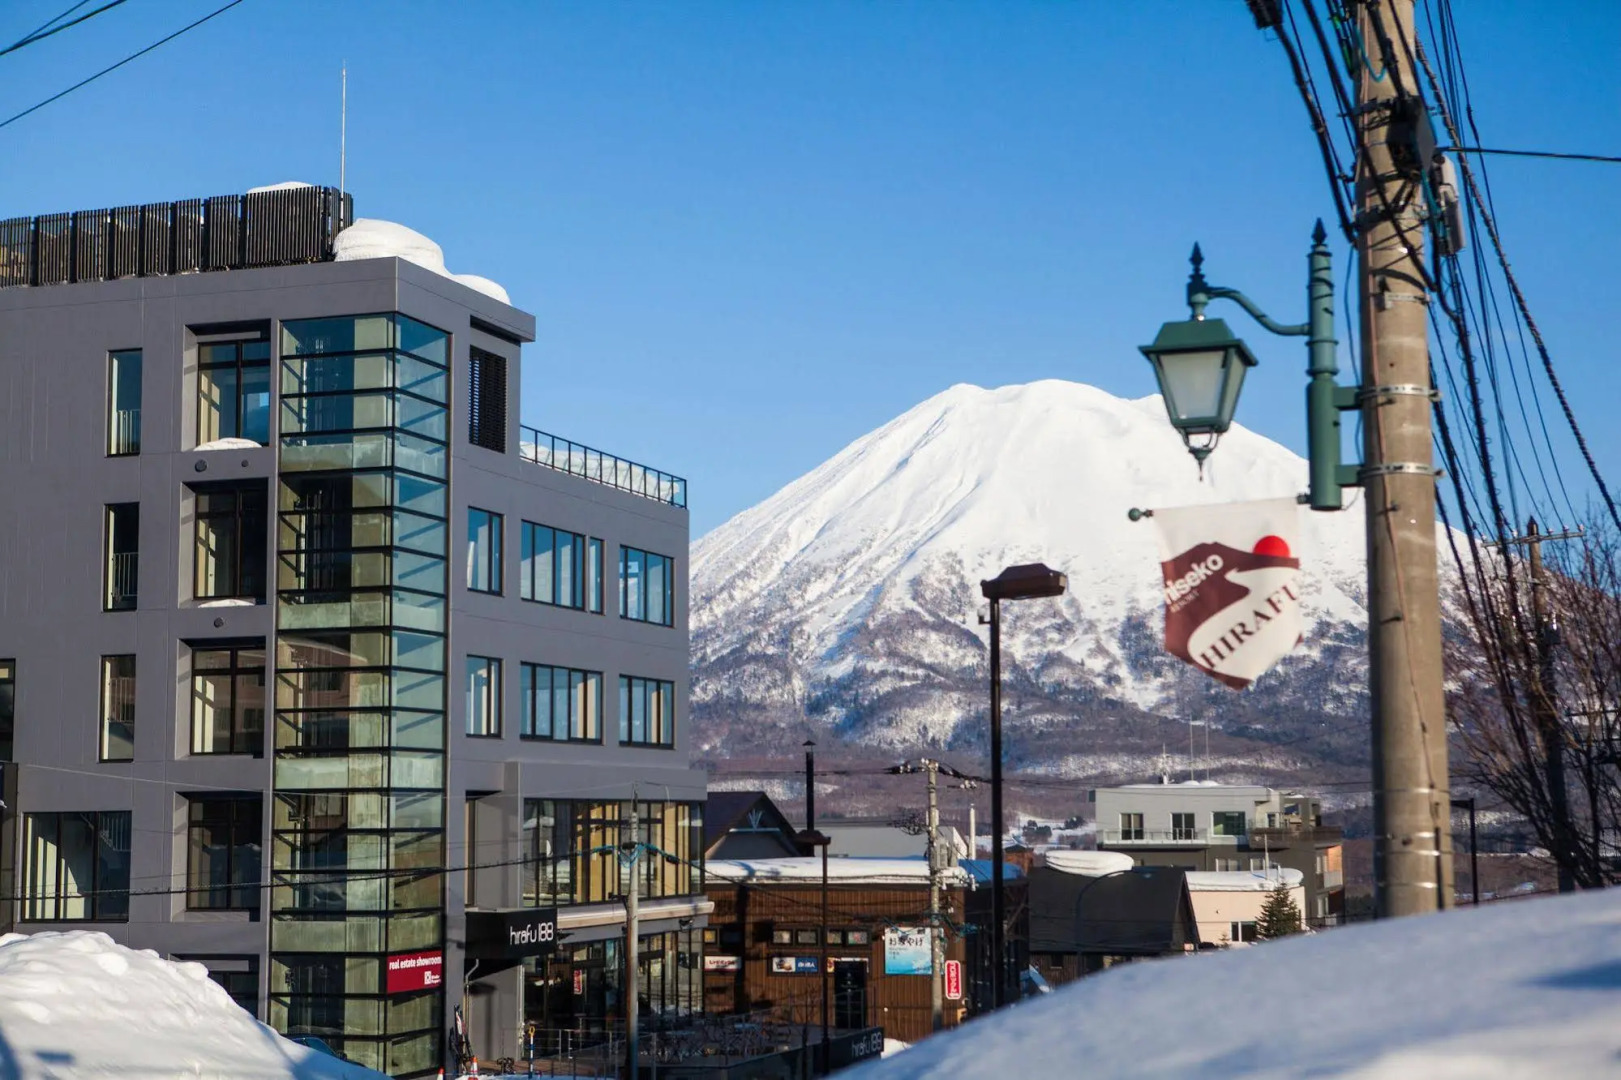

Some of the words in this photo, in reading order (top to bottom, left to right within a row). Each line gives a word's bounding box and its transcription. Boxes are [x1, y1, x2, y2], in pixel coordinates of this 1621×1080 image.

[510, 925, 537, 945] hirafu
[538, 922, 554, 941] 188
[389, 958, 400, 970] real
[400, 958, 416, 969] estate
[416, 956, 442, 967] showroom
